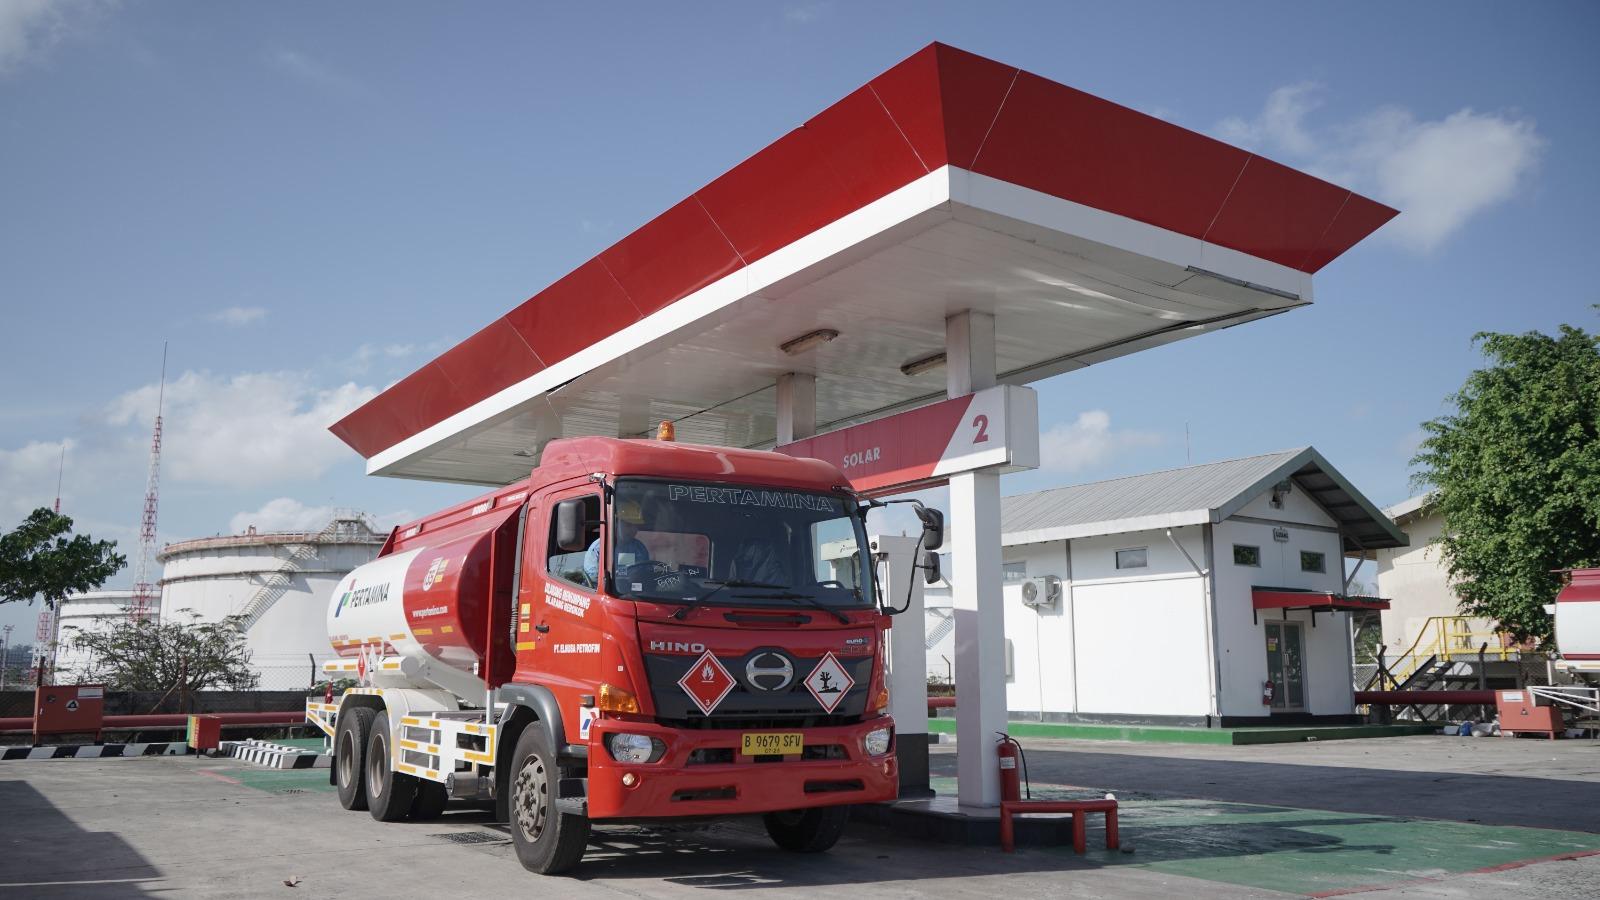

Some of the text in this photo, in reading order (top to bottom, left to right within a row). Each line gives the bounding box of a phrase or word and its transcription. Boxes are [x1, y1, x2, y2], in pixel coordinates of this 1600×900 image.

[972, 414, 989, 444] 2
[843, 447, 881, 469] SOLAR
[668, 484, 834, 512] PERTAMINA
[350, 582, 391, 608] PERTAMINA
[650, 640, 705, 653] HINO
[745, 735, 801, 748] B 9679 SFV
